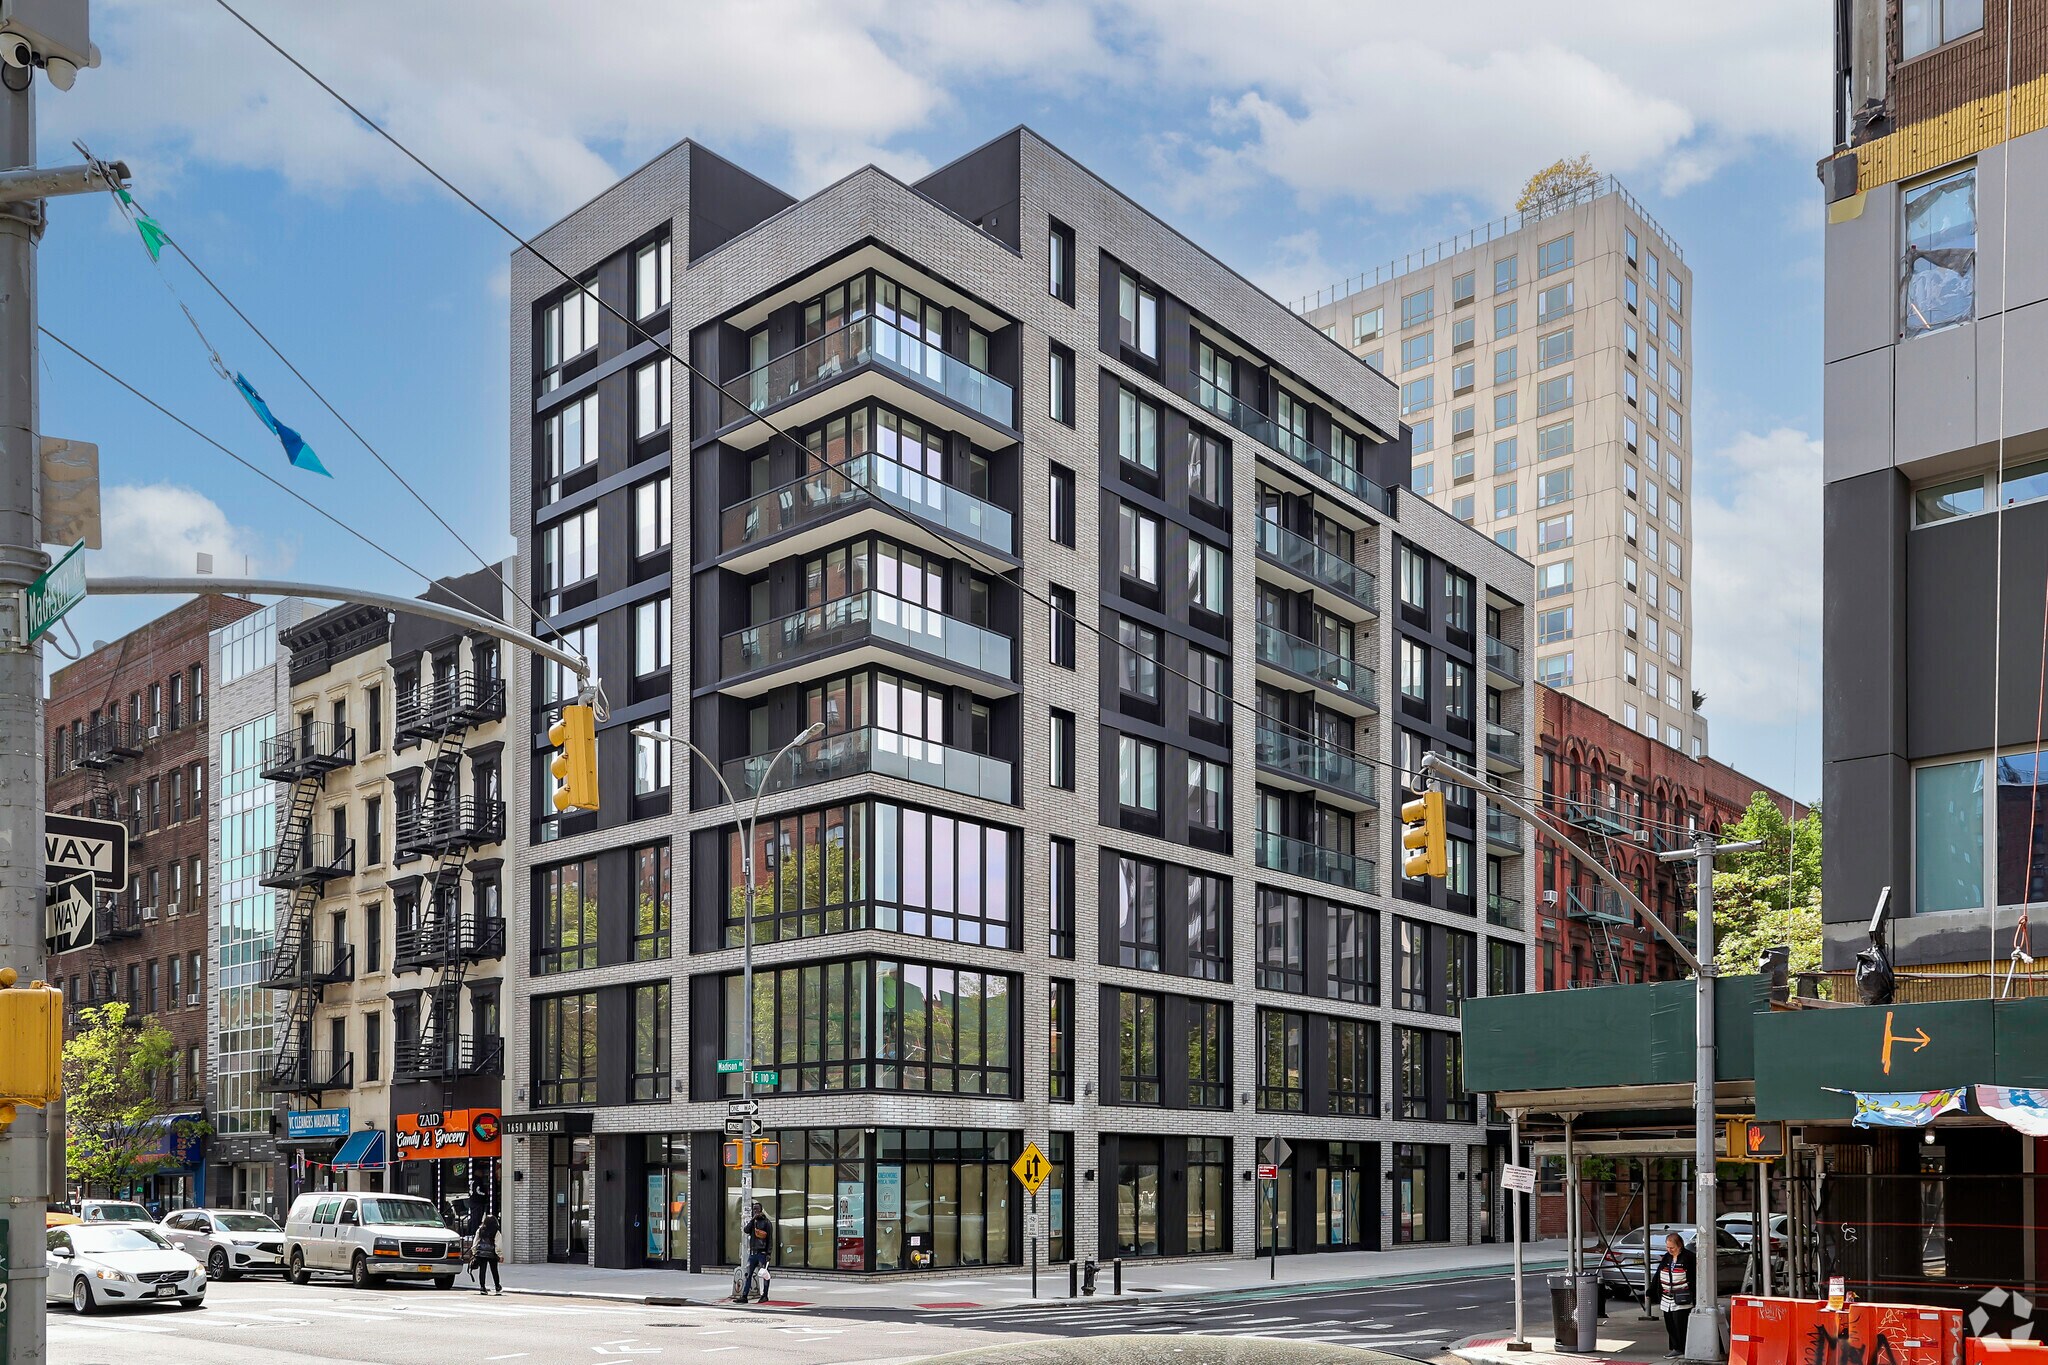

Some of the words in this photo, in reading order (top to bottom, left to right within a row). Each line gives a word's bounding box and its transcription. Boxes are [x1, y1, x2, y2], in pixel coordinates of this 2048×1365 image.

[29, 571, 69, 633] Madison
[54, 900, 81, 931] WAY
[719, 1062, 737, 1071] Madison
[755, 1073, 758, 1082] E
[761, 1074, 769, 1083] 110
[294, 1115, 314, 1129] CLEANERS
[313, 1114, 332, 1128] MADISON
[419, 1113, 440, 1127] ZAID
[507, 1123, 523, 1133] 1650
[526, 1121, 559, 1132] MADISON
[396, 1131, 421, 1149] Candy
[422, 1133, 430, 1147] &
[434, 1128, 466, 1149] Grocery
[841, 1200, 849, 1213] FOR
